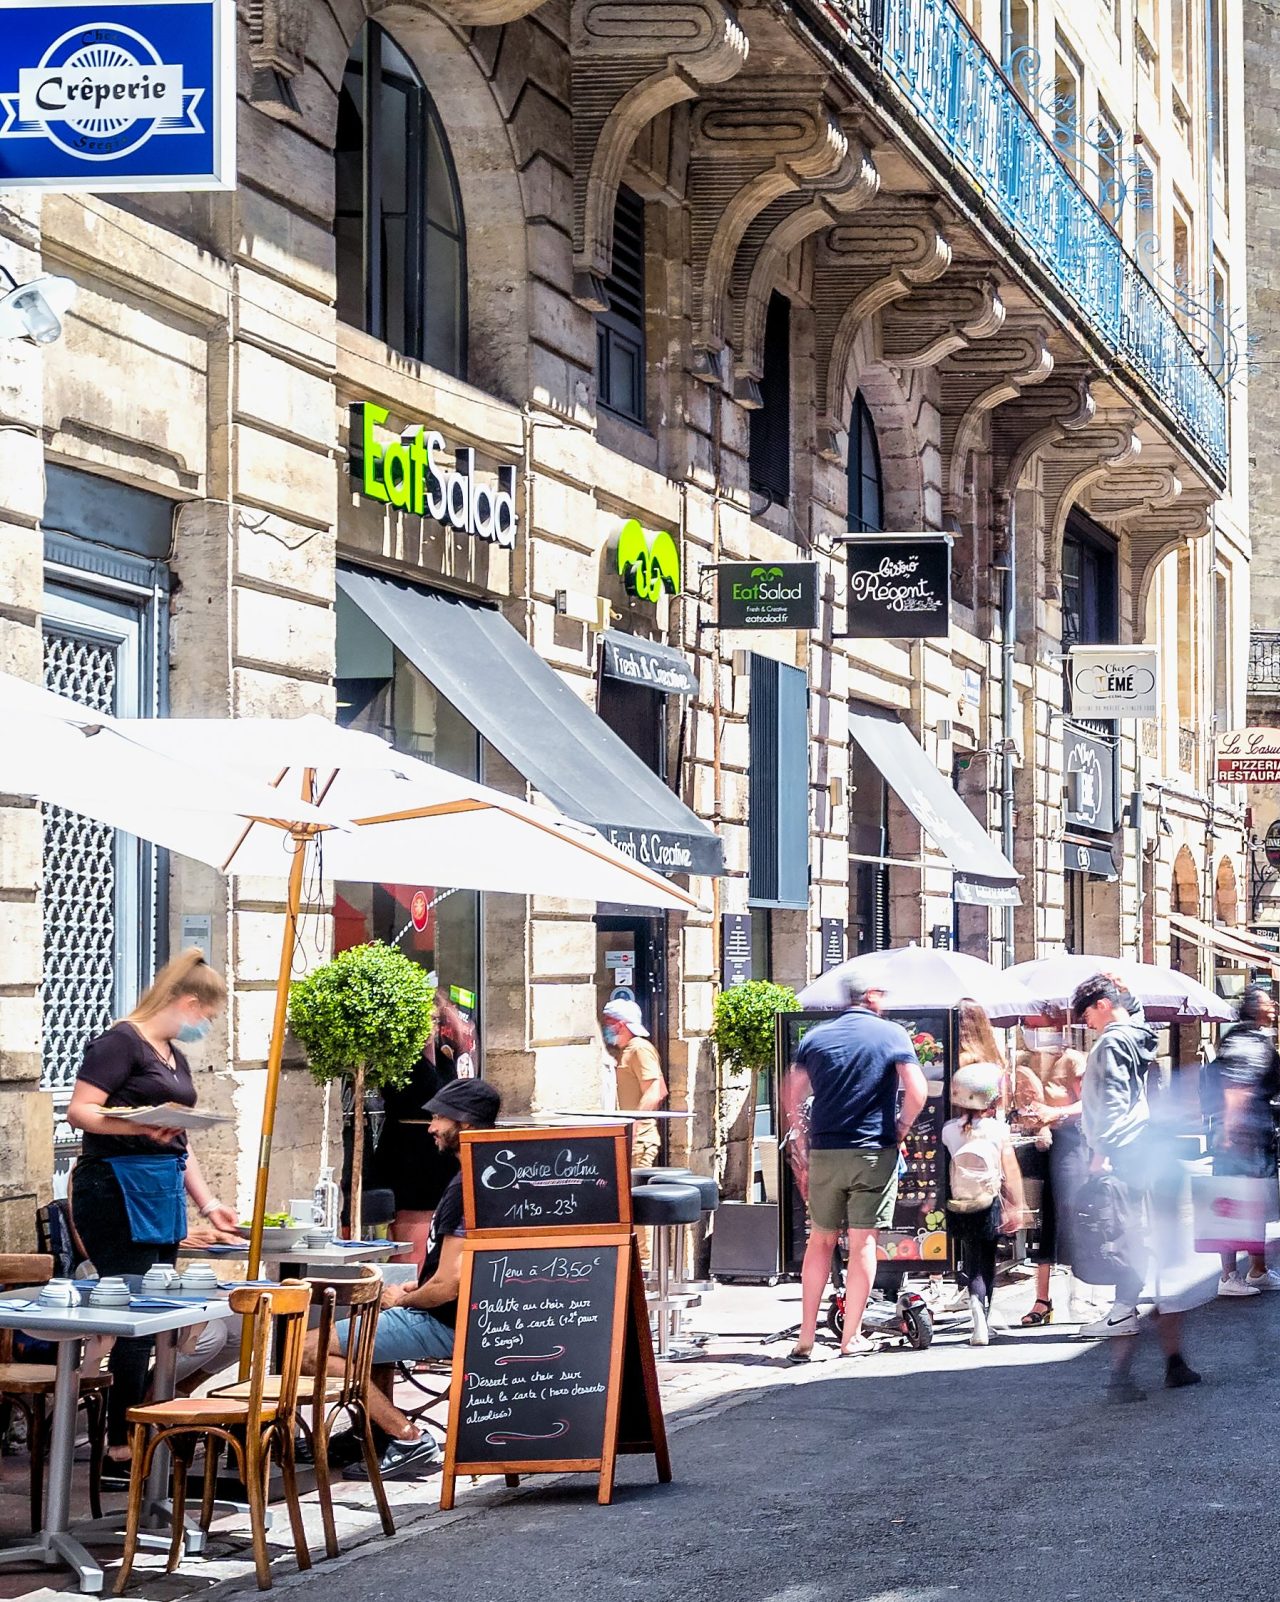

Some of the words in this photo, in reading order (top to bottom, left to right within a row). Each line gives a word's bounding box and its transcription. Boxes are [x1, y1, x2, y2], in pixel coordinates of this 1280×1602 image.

[36, 75, 166, 110] Crêperie
[354, 401, 517, 549] EatSalad
[879, 556, 919, 577] bistro
[733, 583, 801, 600] EatSalad
[745, 613, 789, 623] eatsalad.fr
[1105, 664, 1125, 674] Chez
[1218, 734, 1241, 755] La
[640, 833, 650, 863] &
[650, 834, 692, 867] Creative
[481, 1149, 551, 1190] Service
[504, 1199, 542, 1220] 11h30
[554, 1193, 577, 1216] 23h
[489, 1256, 523, 1289] Menu
[569, 1300, 591, 1309] sur
[515, 1318, 524, 1330] la
[527, 1316, 556, 1328] carte
[511, 1376, 526, 1385] au
[560, 1371, 582, 1381] sur
[465, 1394, 494, 1409] toute
[498, 1391, 508, 1402] la
[512, 1389, 537, 1401] carte
